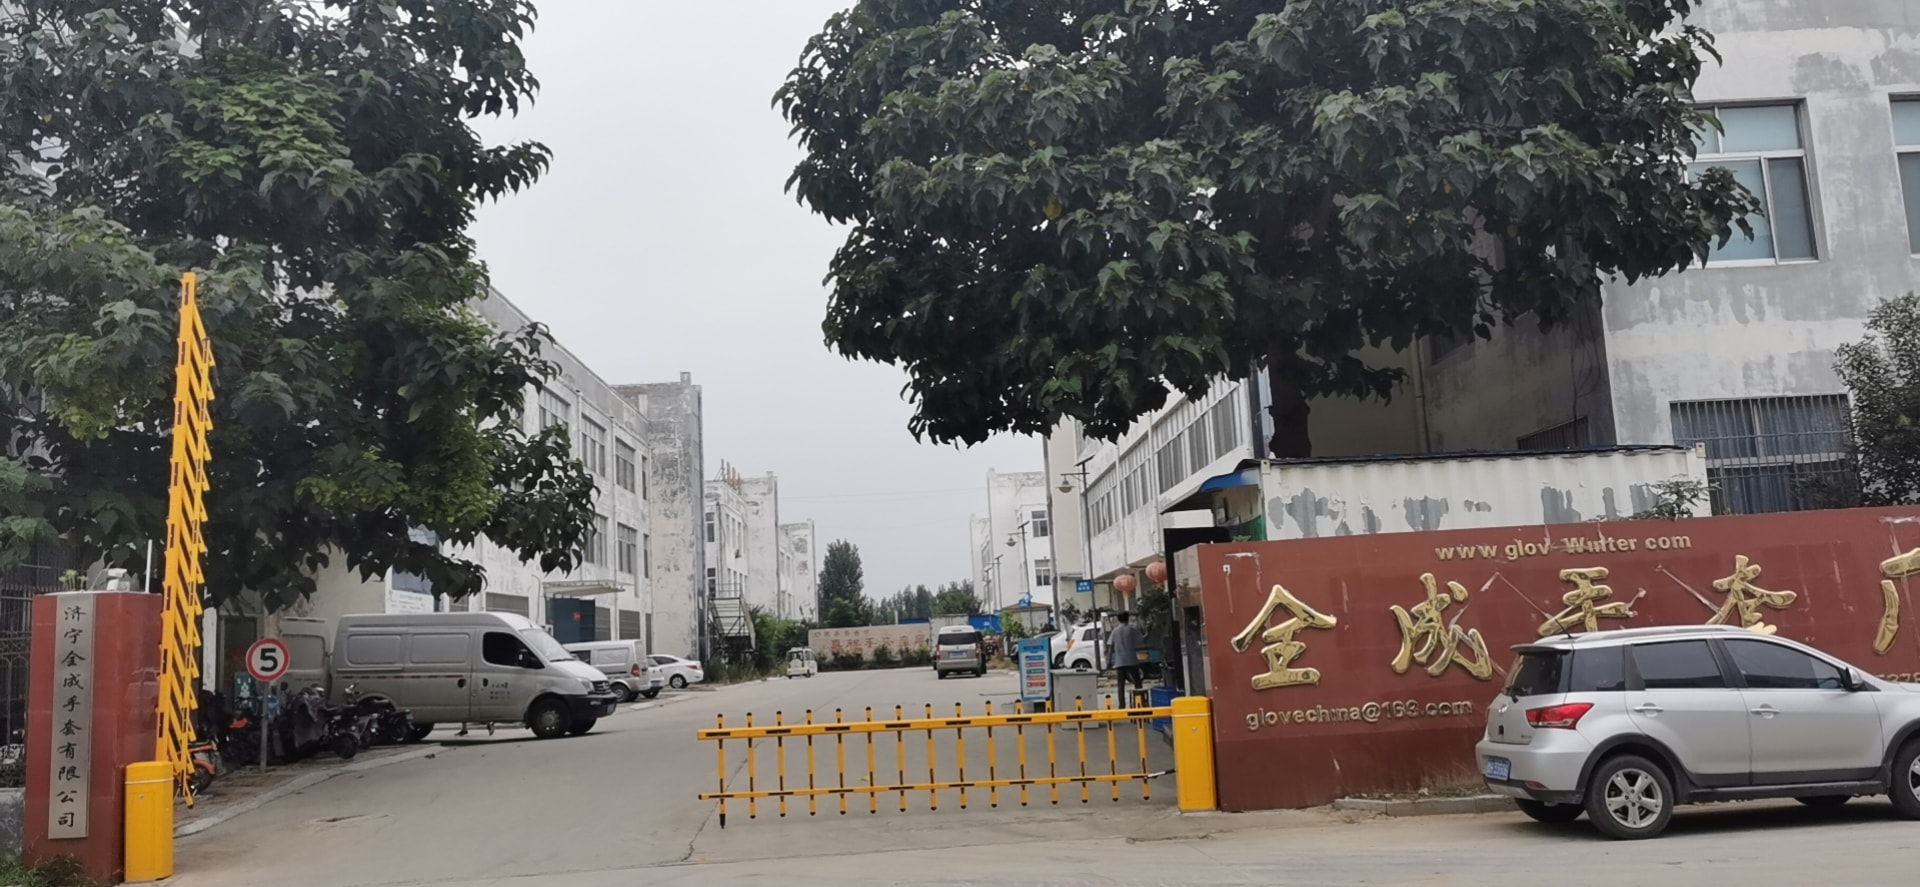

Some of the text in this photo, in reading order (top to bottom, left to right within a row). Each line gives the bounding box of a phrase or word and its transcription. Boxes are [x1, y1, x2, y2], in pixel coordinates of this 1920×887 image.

[56, 605, 87, 828] 济宁金成手套有限公司
[260, 647, 279, 673] 5
